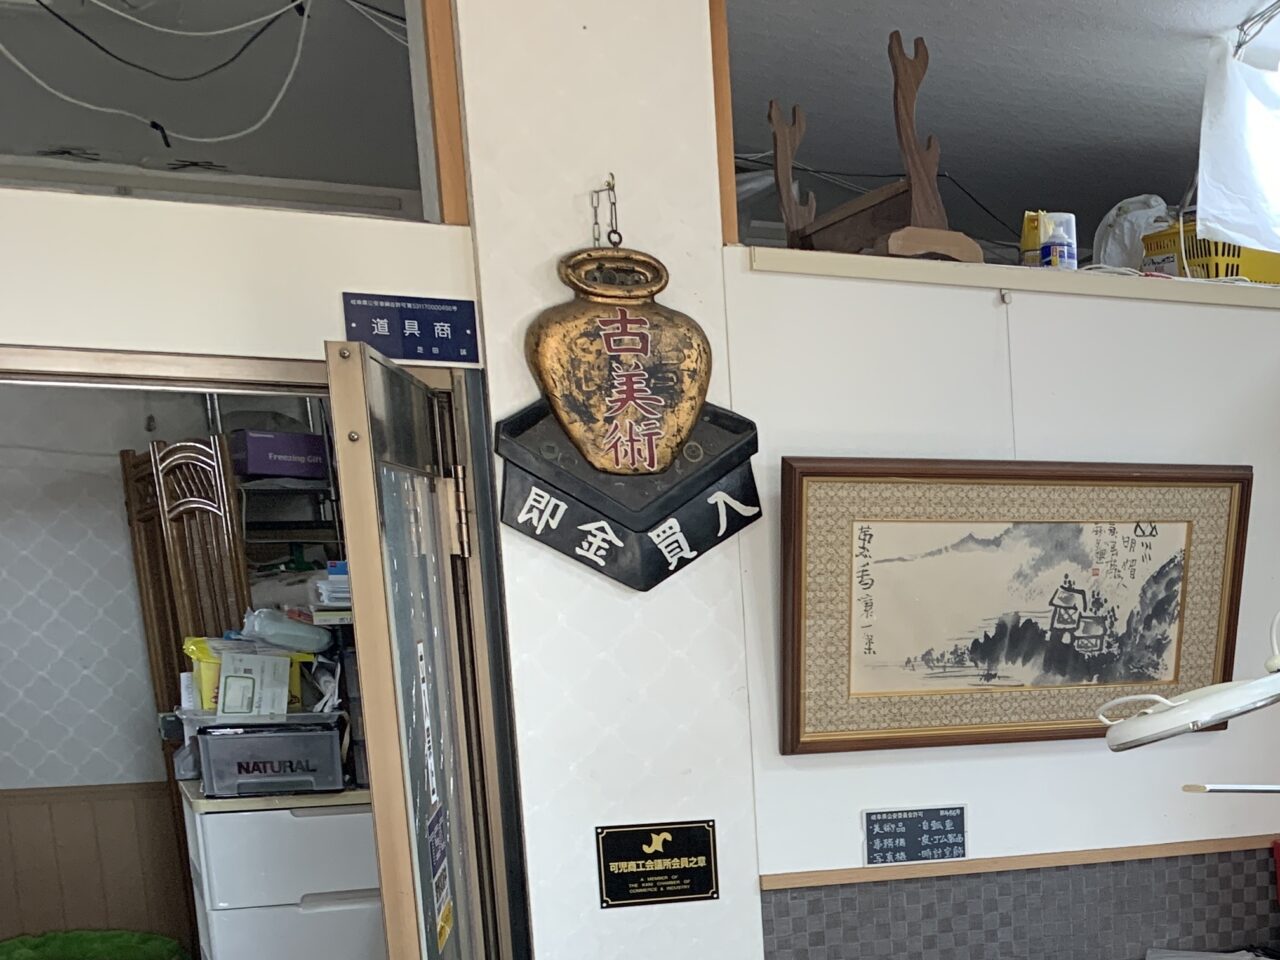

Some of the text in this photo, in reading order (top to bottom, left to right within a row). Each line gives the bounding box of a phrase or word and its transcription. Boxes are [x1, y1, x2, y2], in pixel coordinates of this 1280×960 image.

[371, 318, 451, 339] 道具商
[598, 307, 665, 470] 古美術
[268, 453, 305, 463] Freezing
[237, 760, 317, 774] NATURAL
[609, 856, 706, 873] 可児商工会議所会員之章
